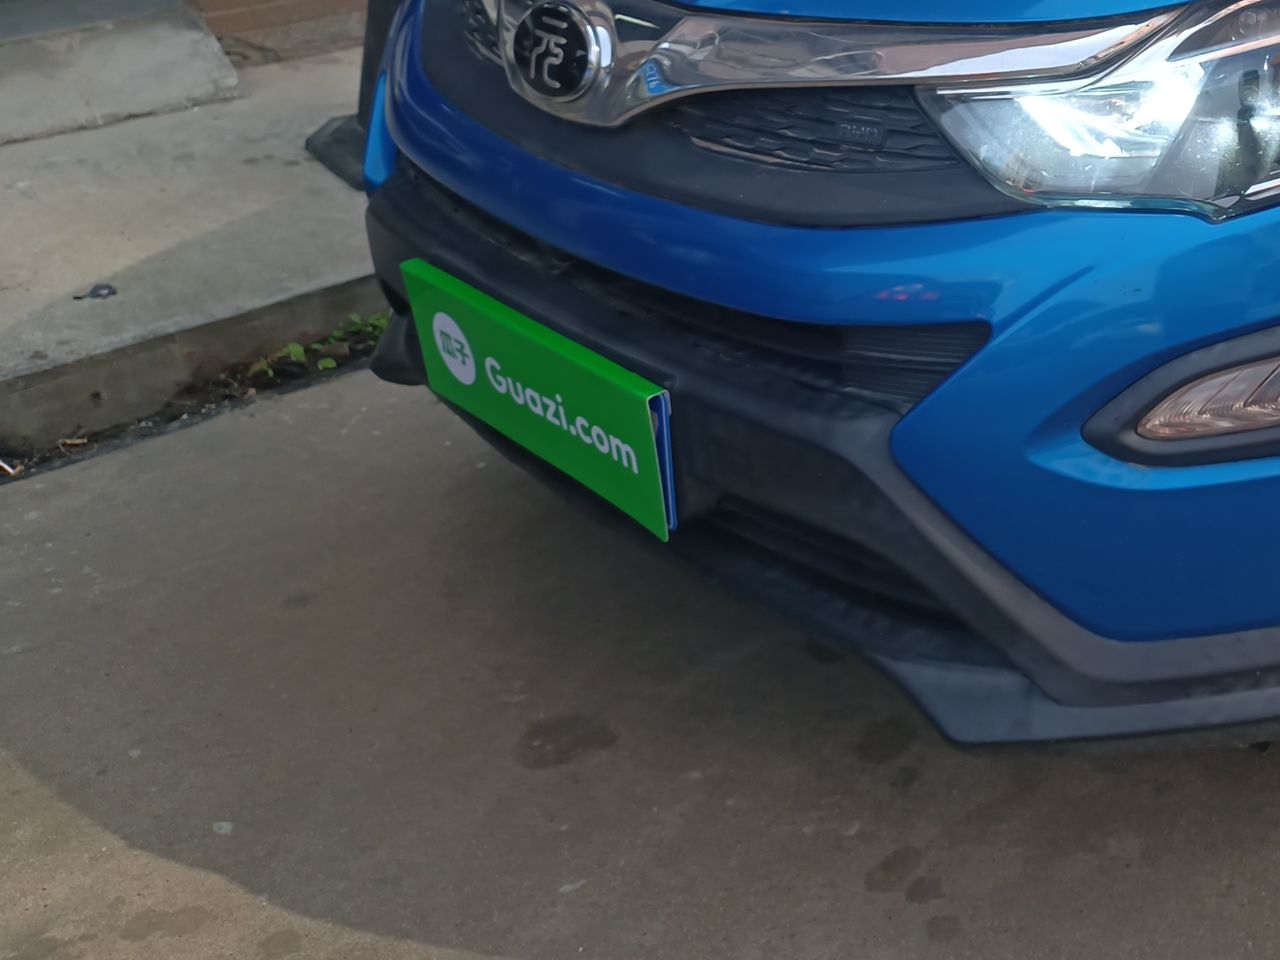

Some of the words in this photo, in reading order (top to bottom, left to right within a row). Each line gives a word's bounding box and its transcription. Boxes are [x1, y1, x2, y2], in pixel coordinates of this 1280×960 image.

[529, 15, 569, 89] 元
[439, 330, 470, 367] 瓜子
[484, 356, 640, 475] Guazi.com
